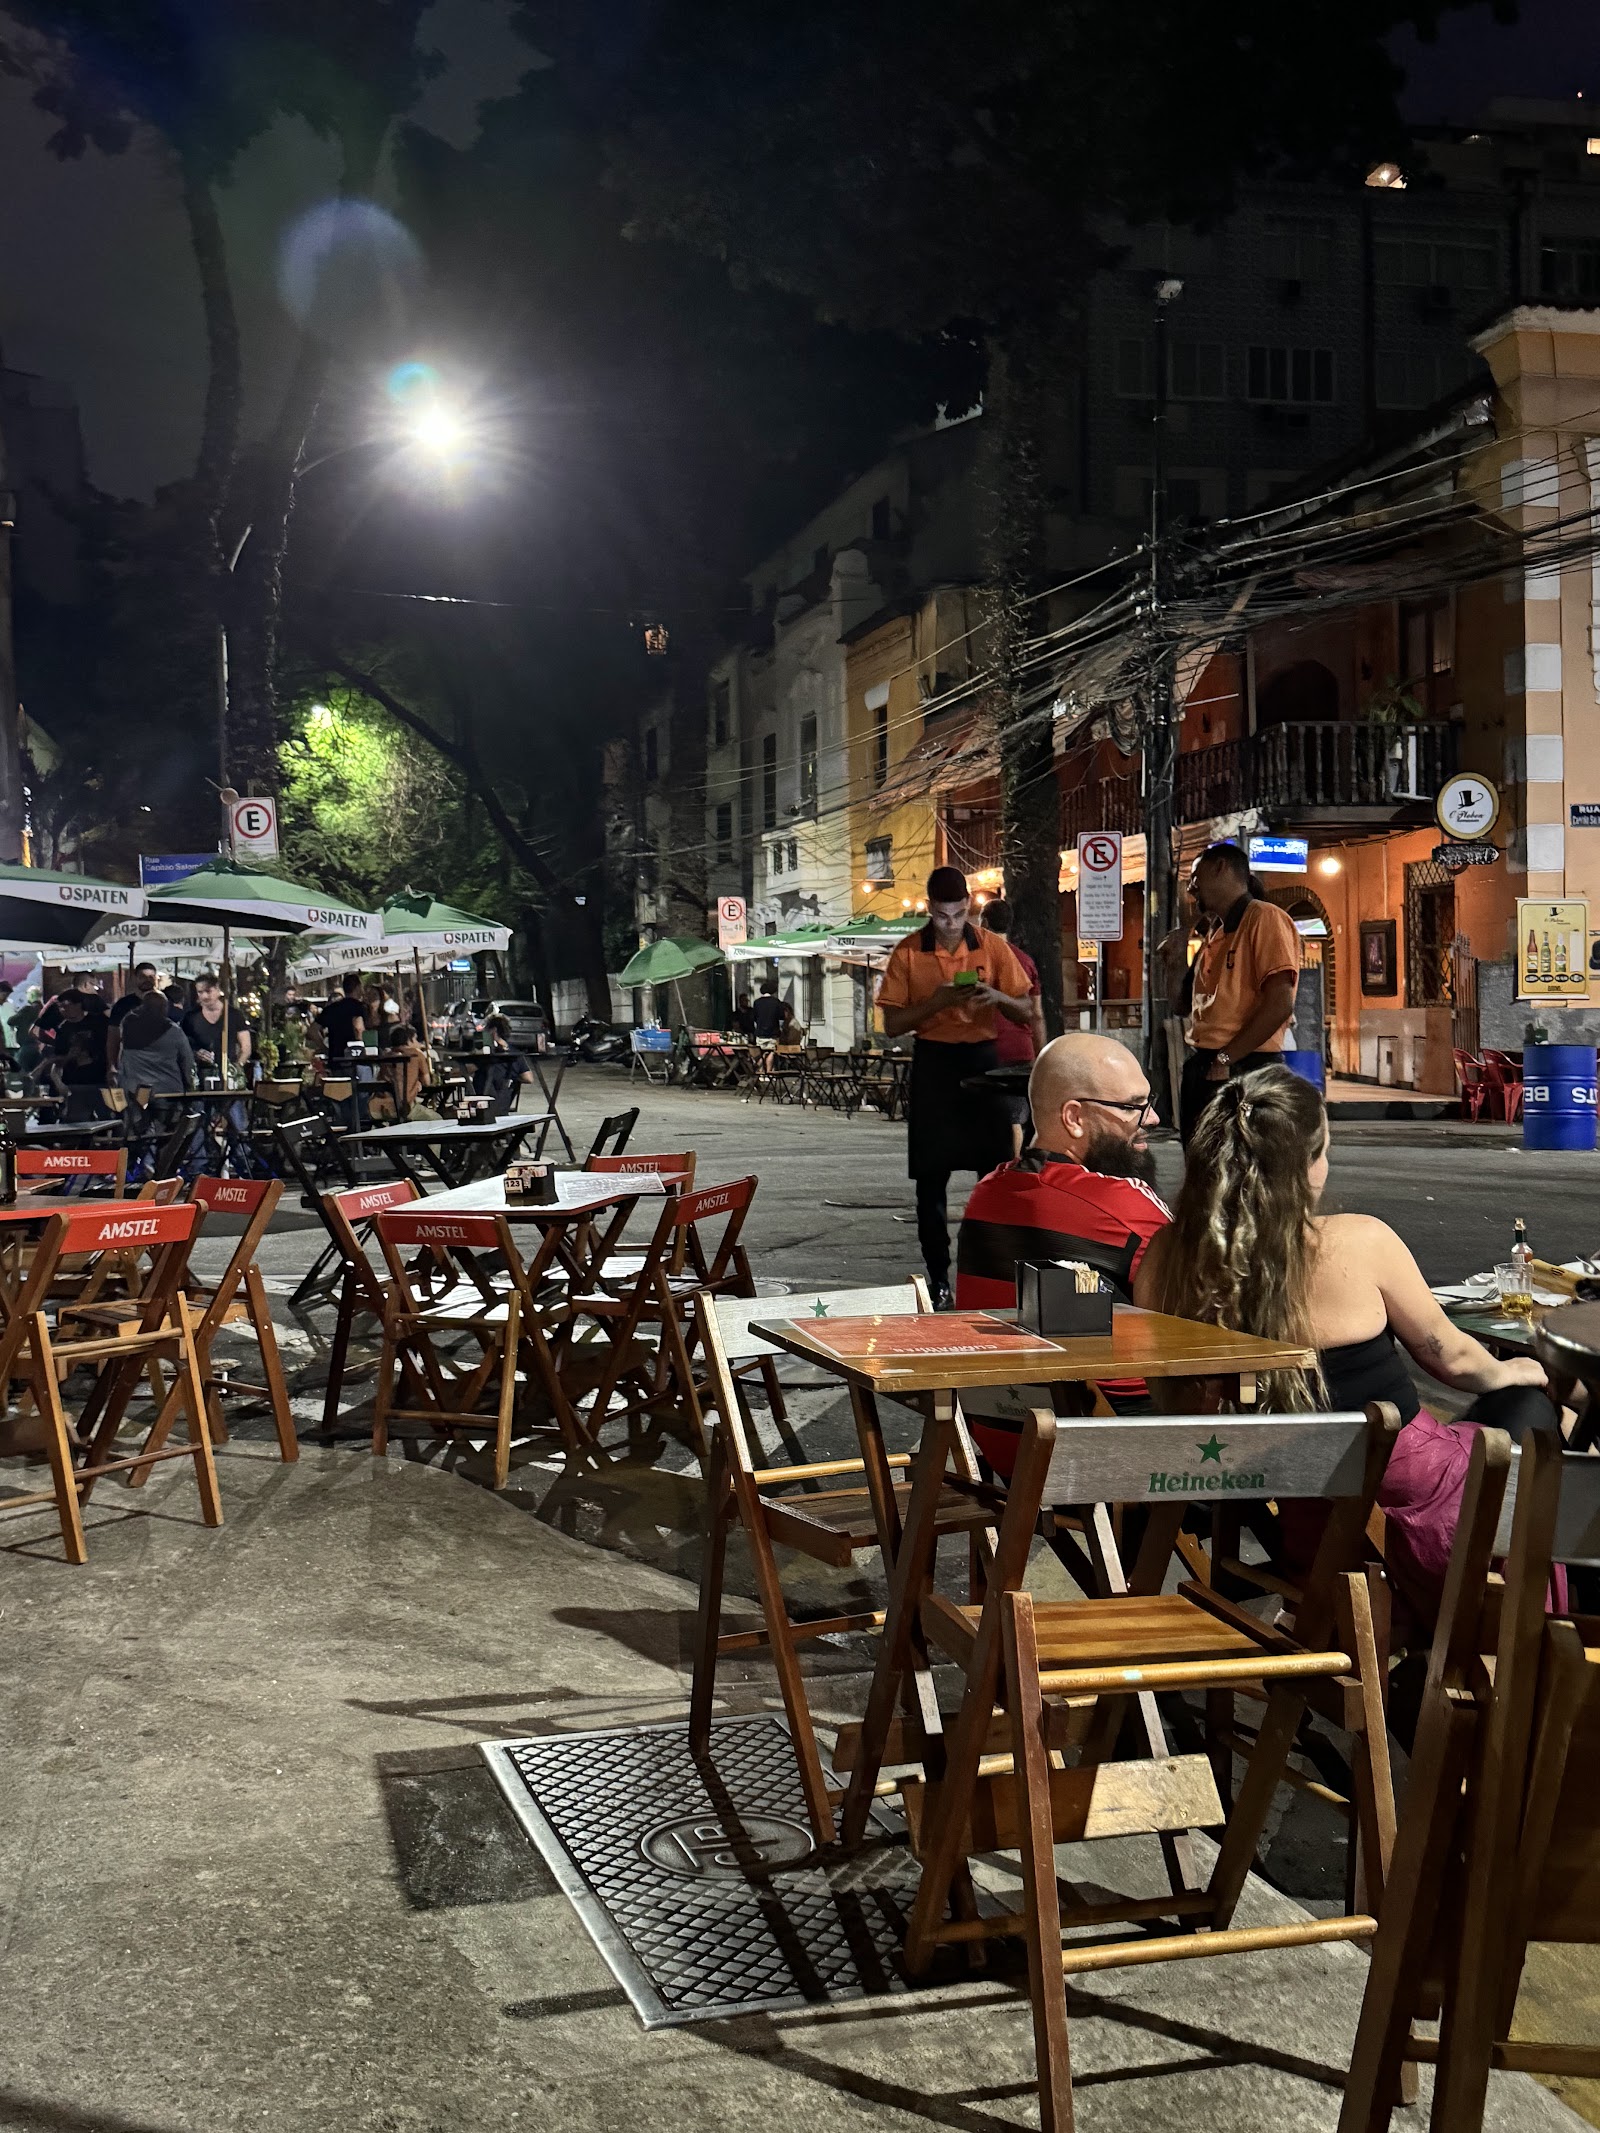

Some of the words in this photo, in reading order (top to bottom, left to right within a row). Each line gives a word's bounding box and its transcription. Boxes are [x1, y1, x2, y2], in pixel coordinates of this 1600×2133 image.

[246, 810, 260, 831] E
[144, 856, 160, 864] Rua
[1093, 843, 1107, 864] E
[74, 887, 128, 905] SPATEN
[728, 904, 737, 917] E
[320, 910, 368, 930] SPATEN
[454, 931, 496, 944] SPATEN
[43, 1156, 92, 1168] AMSTEL
[619, 1162, 660, 1172] AMSTEL
[505, 1179, 520, 1188] 123
[214, 1186, 249, 1203] AMSTEL
[360, 1193, 394, 1209] AMSTEL
[695, 1193, 730, 1212] AMSTEL
[98, 1218, 160, 1240] AMSTEL
[415, 1224, 468, 1239] AMSTEL
[1148, 1469, 1267, 1493] Heineken
